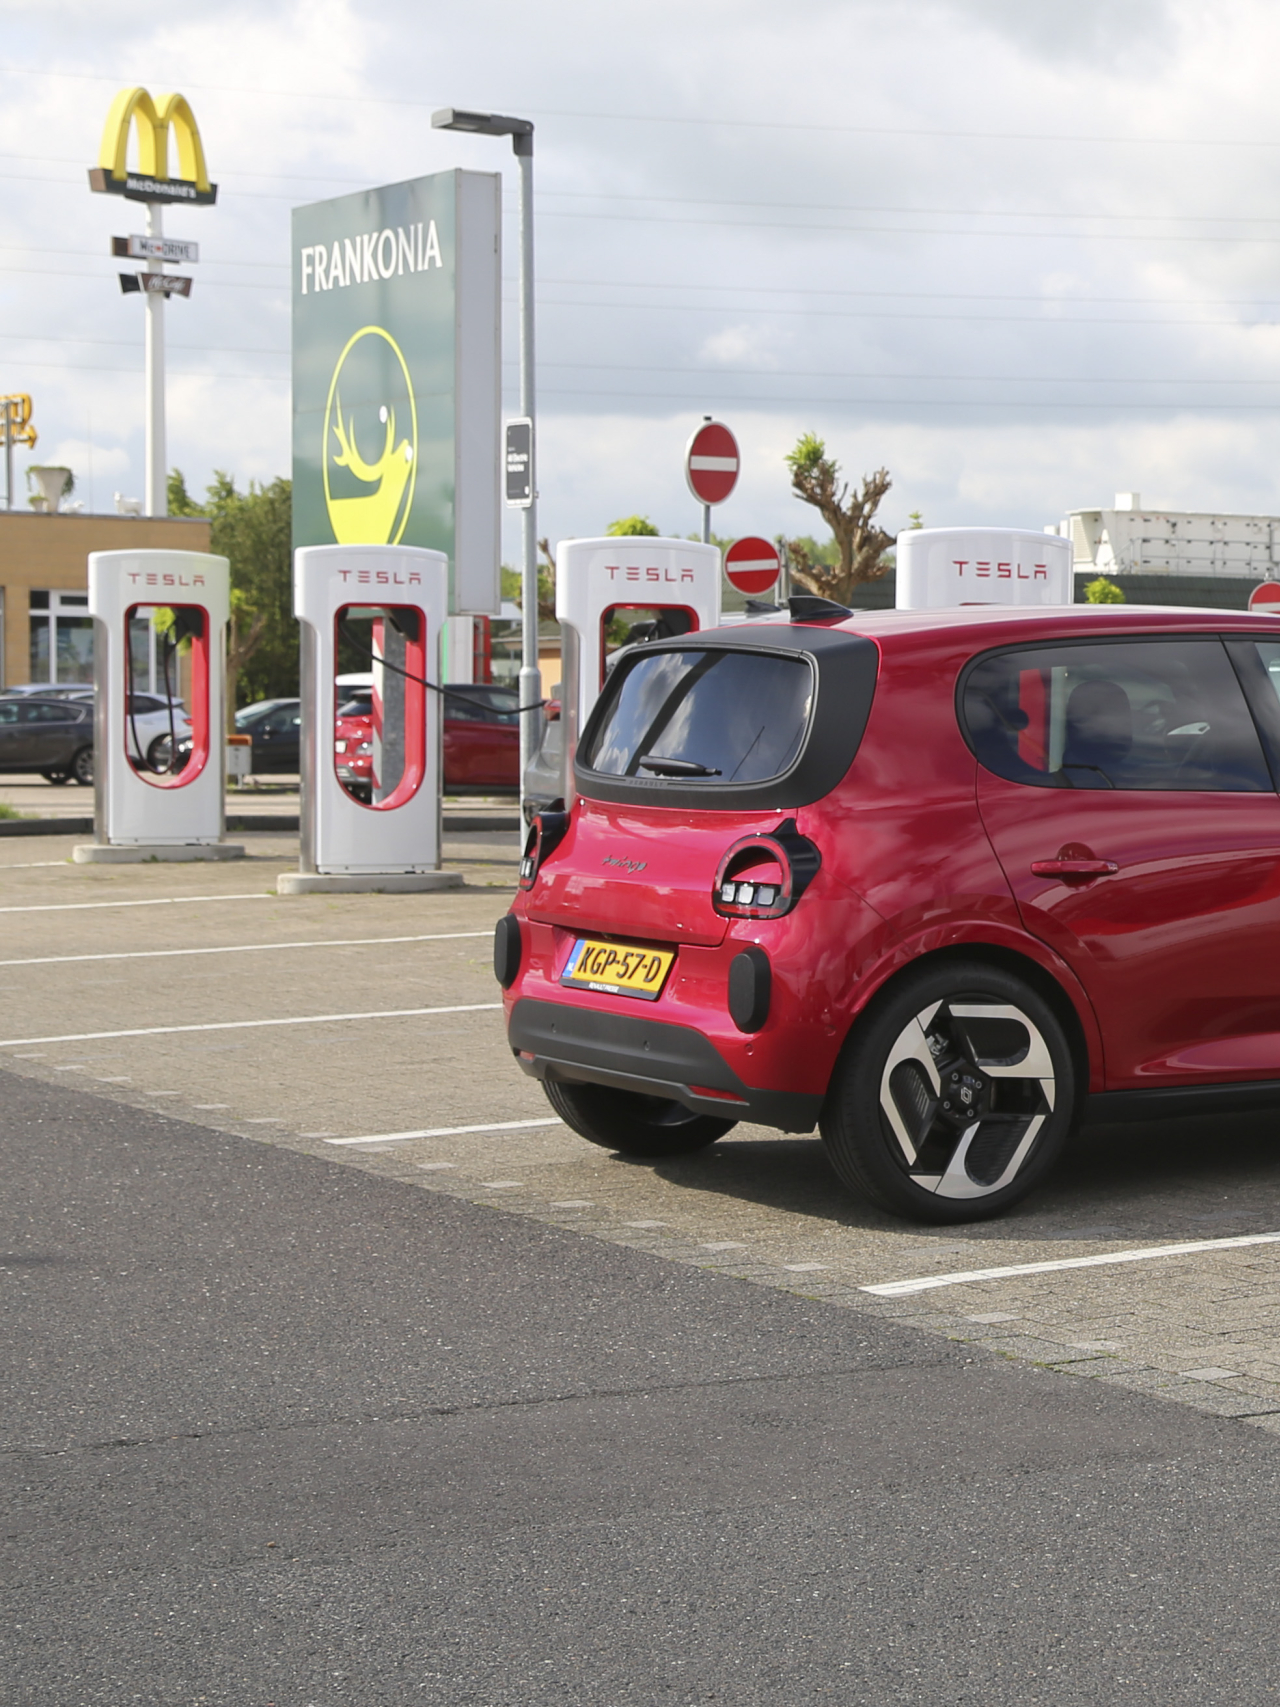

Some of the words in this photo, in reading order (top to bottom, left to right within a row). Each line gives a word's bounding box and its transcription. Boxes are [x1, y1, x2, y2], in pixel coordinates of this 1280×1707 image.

[126, 178, 197, 198] McDonald's
[301, 219, 443, 295] FRANKONIA
[127, 573, 206, 586] TESLA
[337, 570, 422, 585] TESLA
[604, 566, 694, 582] TESLA
[951, 560, 1047, 580] TESLA
[602, 855, 648, 875] twingo
[577, 946, 662, 983] KGP-57-D
